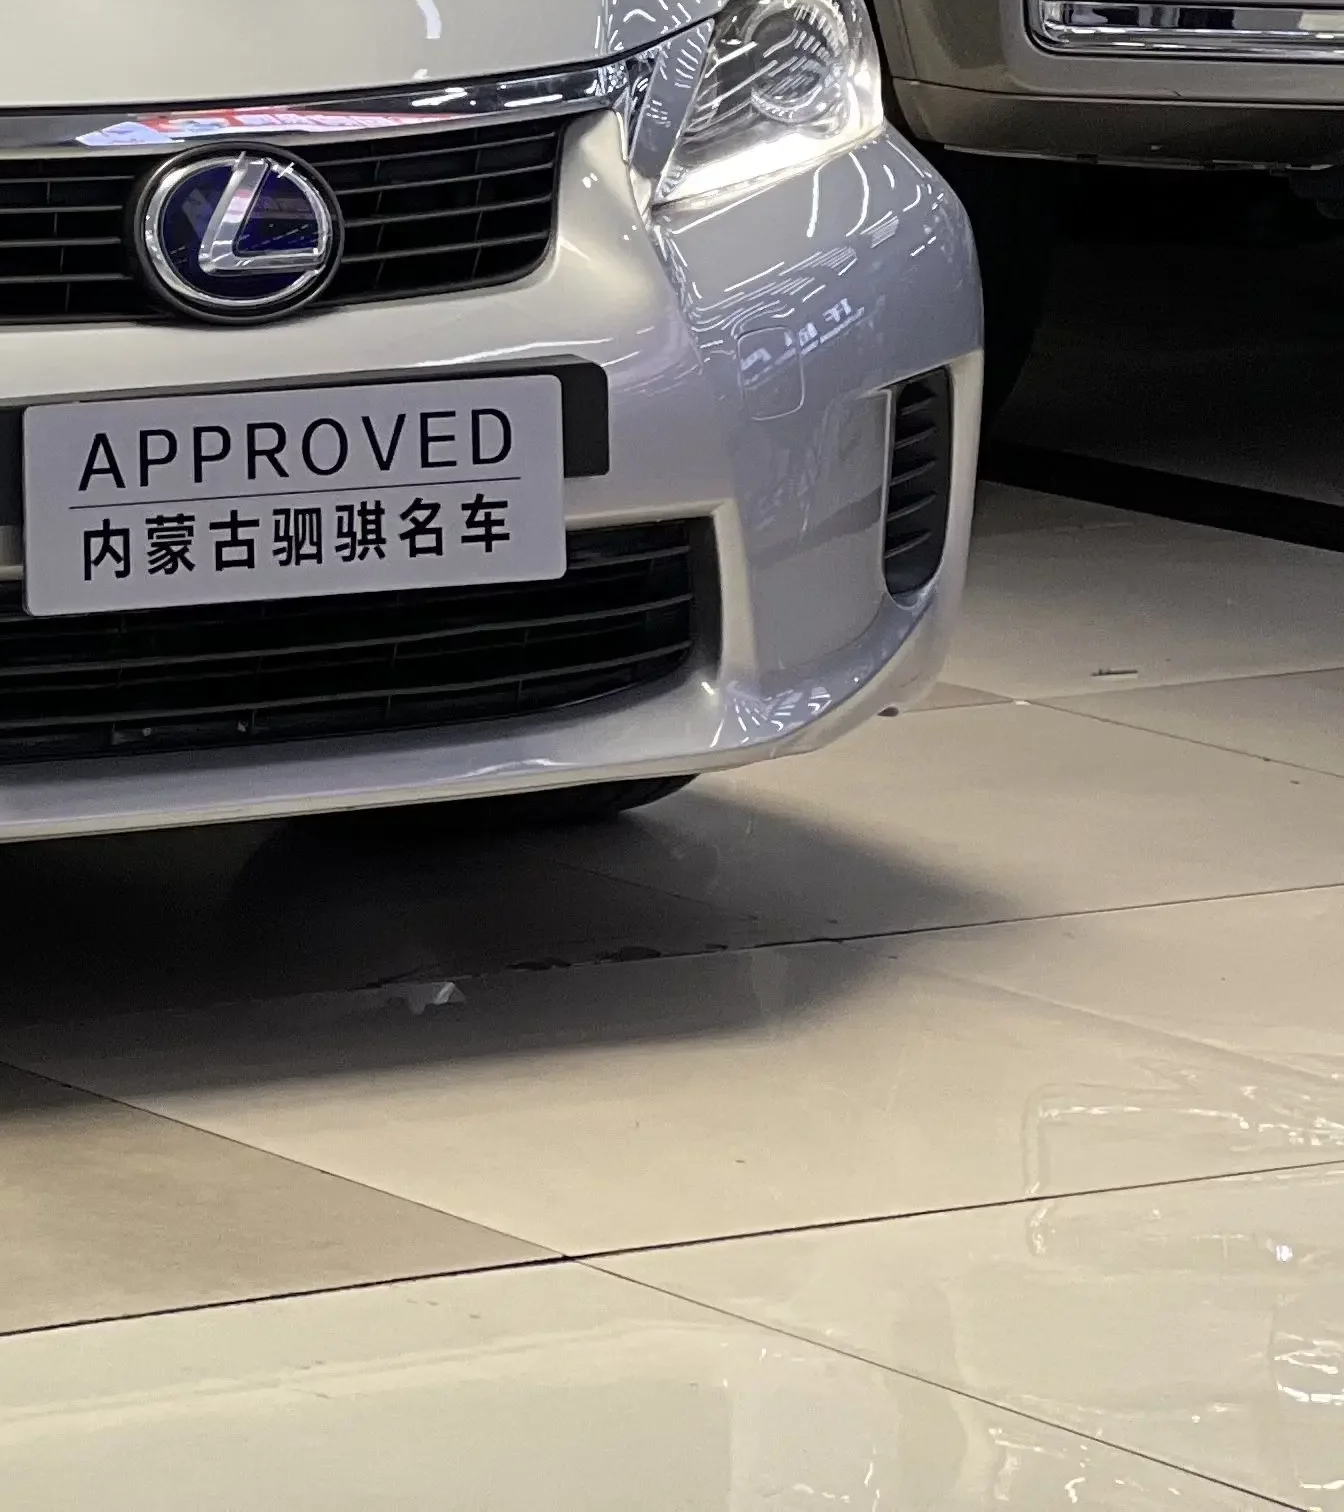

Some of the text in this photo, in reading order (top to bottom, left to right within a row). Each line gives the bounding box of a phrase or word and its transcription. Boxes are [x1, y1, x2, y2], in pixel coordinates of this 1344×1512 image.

[78, 406, 513, 492] APPROVED
[82, 493, 512, 581] 内蒙古驷骐名车
